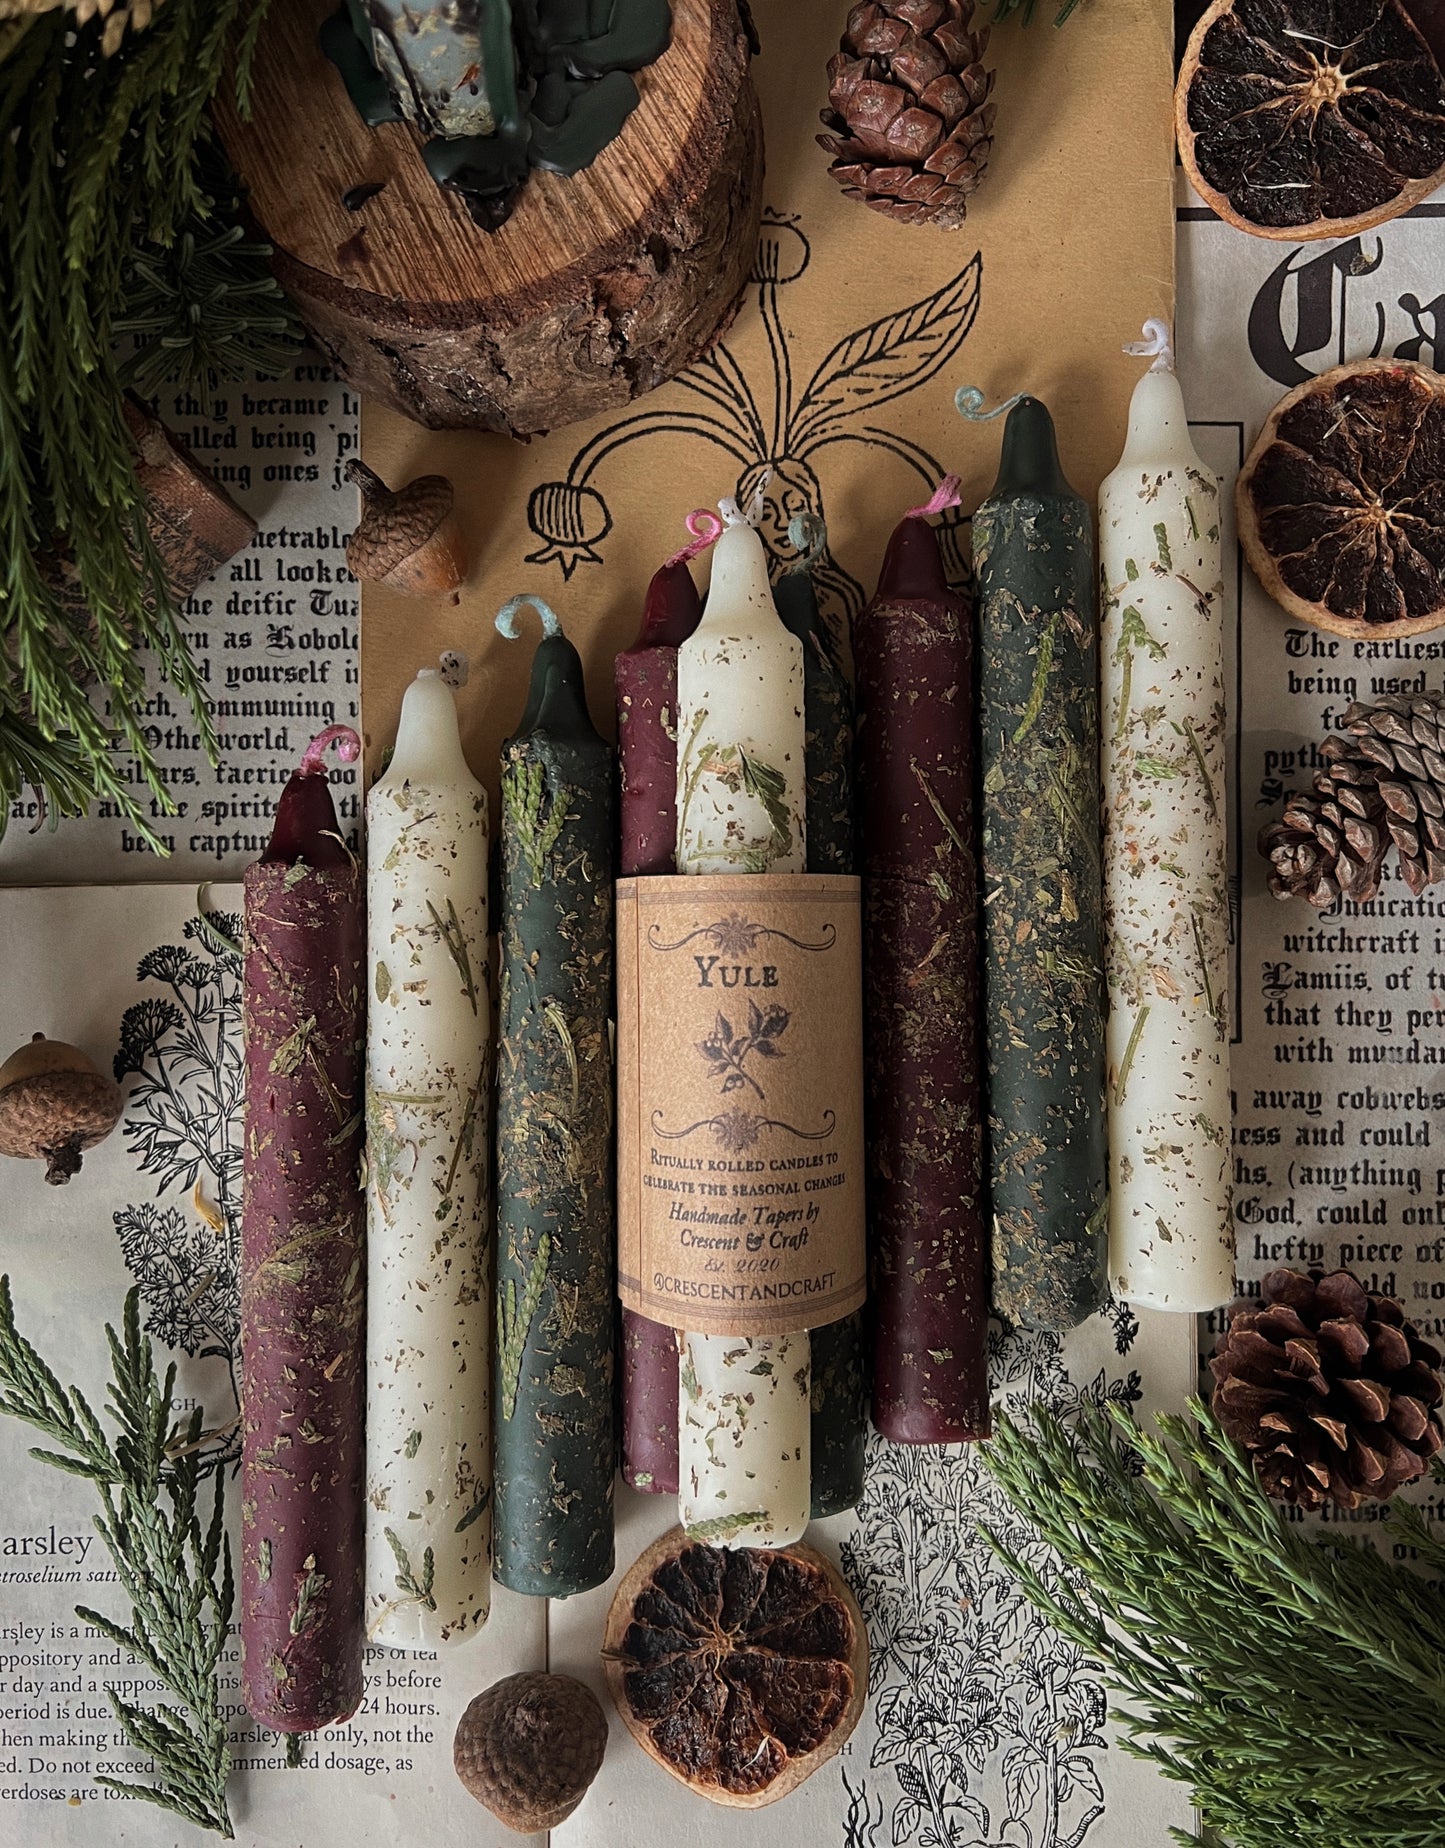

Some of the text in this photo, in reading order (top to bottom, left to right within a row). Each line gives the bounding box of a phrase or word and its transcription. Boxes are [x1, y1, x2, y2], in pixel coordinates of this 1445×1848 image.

[242, 392, 329, 416] became
[176, 424, 238, 449] alled
[252, 423, 316, 457] being
[263, 463, 319, 483] ones
[230, 558, 263, 583] all
[226, 590, 297, 616] deific
[223, 631, 252, 649] as
[1284, 628, 1340, 659] The
[225, 660, 331, 692] yourself
[1288, 668, 1427, 703] being used
[192, 693, 335, 725] ommuning
[215, 759, 293, 785] faerie
[1283, 926, 1420, 954] witchcraft
[1385, 965, 1413, 991] of
[1264, 999, 1321, 1026] that
[1334, 1000, 1392, 1036] they
[1273, 1036, 1333, 1064] with
[1253, 1088, 1323, 1119] away
[1295, 1119, 1345, 1147] and
[1359, 1120, 1431, 1148] could
[668, 1200, 820, 1229] Handmade Tapers by
[1316, 1198, 1388, 1226] could
[680, 1228, 740, 1251] Crescent
[769, 1226, 809, 1251] Craft
[1253, 1234, 1325, 1268] hefty
[1338, 1234, 1404, 1268] piece
[733, 1256, 780, 1273] 2020
[3, 1525, 94, 1565] arsley
[0, 1621, 45, 1645] rsley
[50, 1622, 64, 1639] is
[69, 1627, 79, 1639] a
[88, 1649, 121, 1666] and
[12, 1675, 44, 1698] day
[50, 1675, 82, 1692] and
[88, 1681, 97, 1692] a
[103, 1679, 170, 1698] suppos
[386, 1669, 442, 1688] before
[56, 1703, 70, 1720] is
[75, 1702, 113, 1720] due.
[360, 1696, 441, 1716] 24 hours.
[39, 1729, 108, 1752] making
[324, 1723, 369, 1748] only,
[373, 1729, 402, 1744] not
[406, 1725, 434, 1744] the
[28, 1758, 57, 1775] Do
[62, 1759, 92, 1774] not
[96, 1757, 155, 1775] exceed
[325, 1752, 391, 1776] dosage,
[396, 1758, 414, 1771] as
[71, 1787, 99, 1800] are
